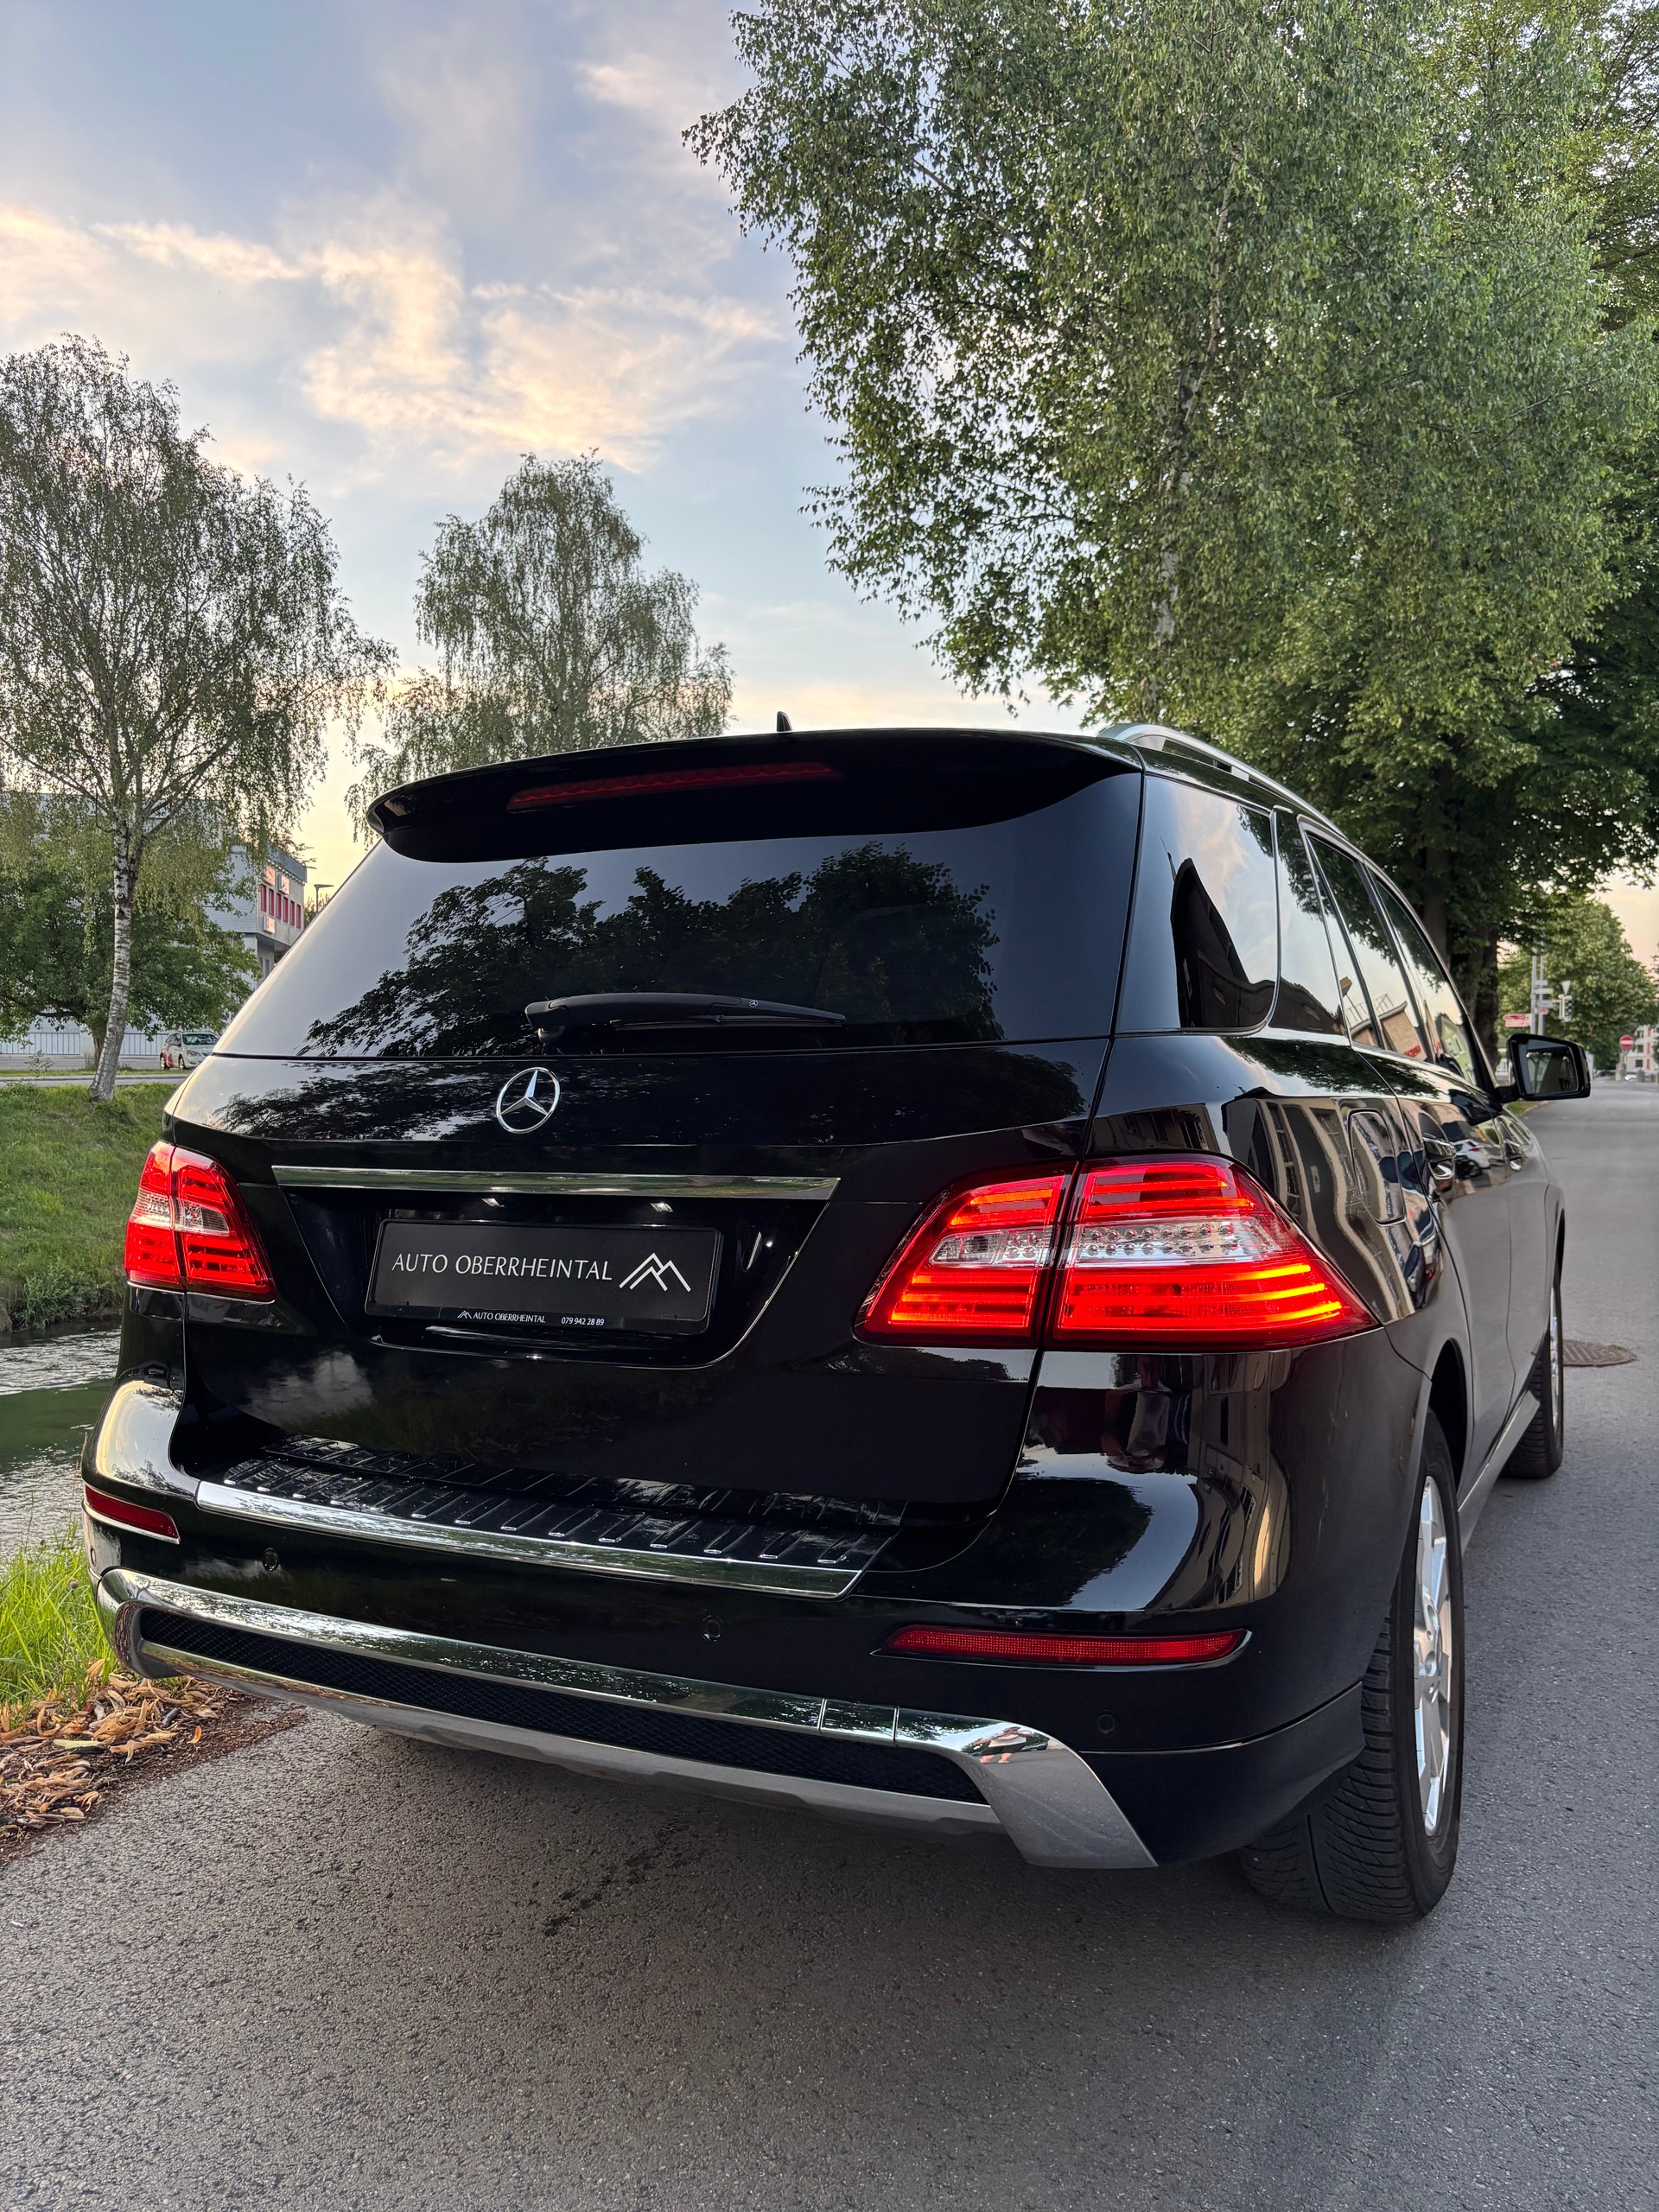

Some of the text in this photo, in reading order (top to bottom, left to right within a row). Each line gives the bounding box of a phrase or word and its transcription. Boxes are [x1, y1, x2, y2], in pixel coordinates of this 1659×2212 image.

[391, 1253, 613, 1281] AUTO OBERRHEINTAL
[473, 1312, 493, 1320] AUTO
[494, 1313, 545, 1323] OBERRHEINTAL
